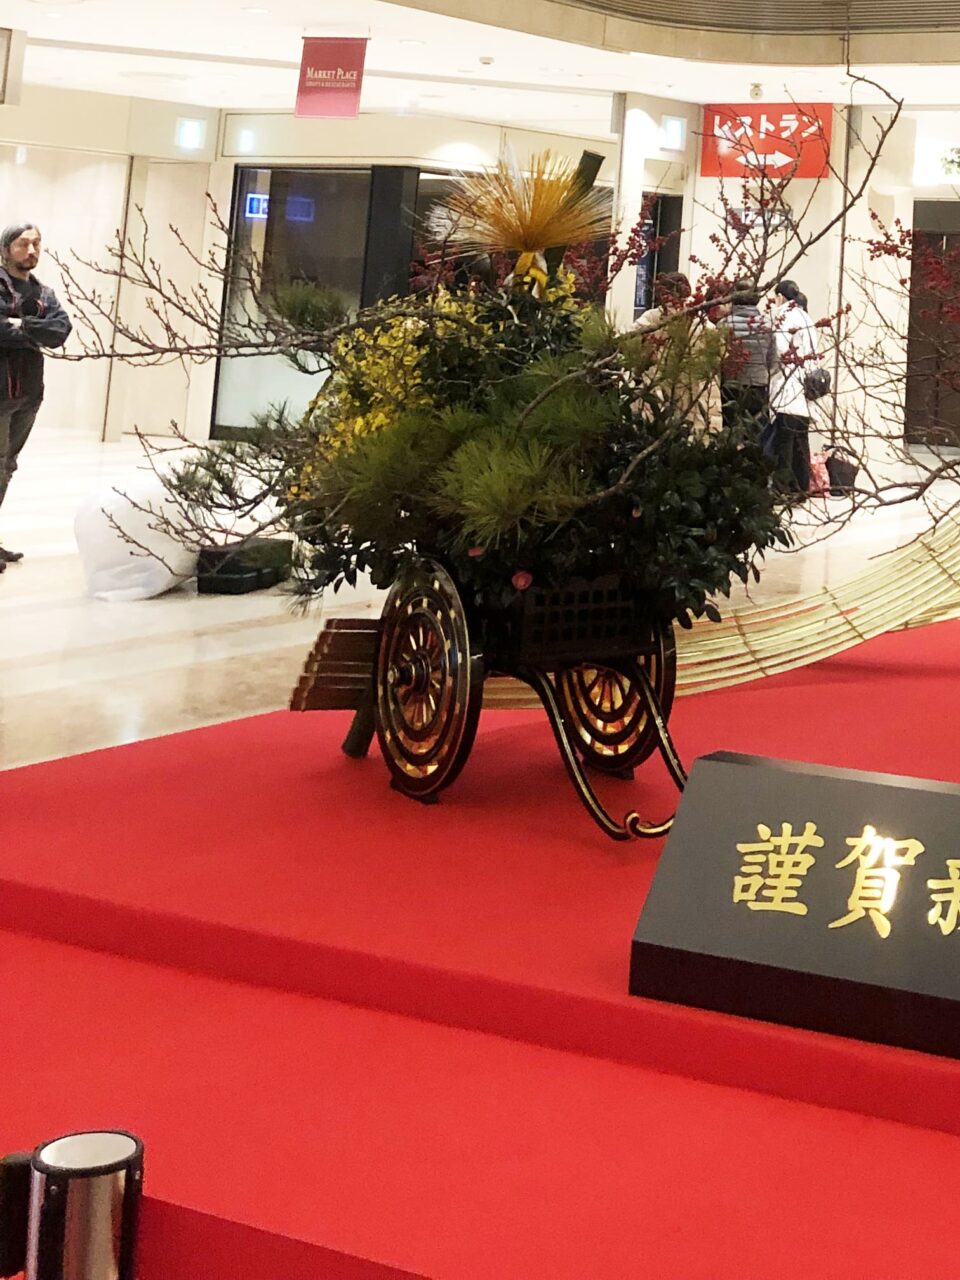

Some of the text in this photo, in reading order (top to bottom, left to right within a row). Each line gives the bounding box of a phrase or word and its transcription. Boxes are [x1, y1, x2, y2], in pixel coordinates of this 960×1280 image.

[306, 67, 358, 80] MARKET PLACE
[713, 113, 823, 139] レストラン
